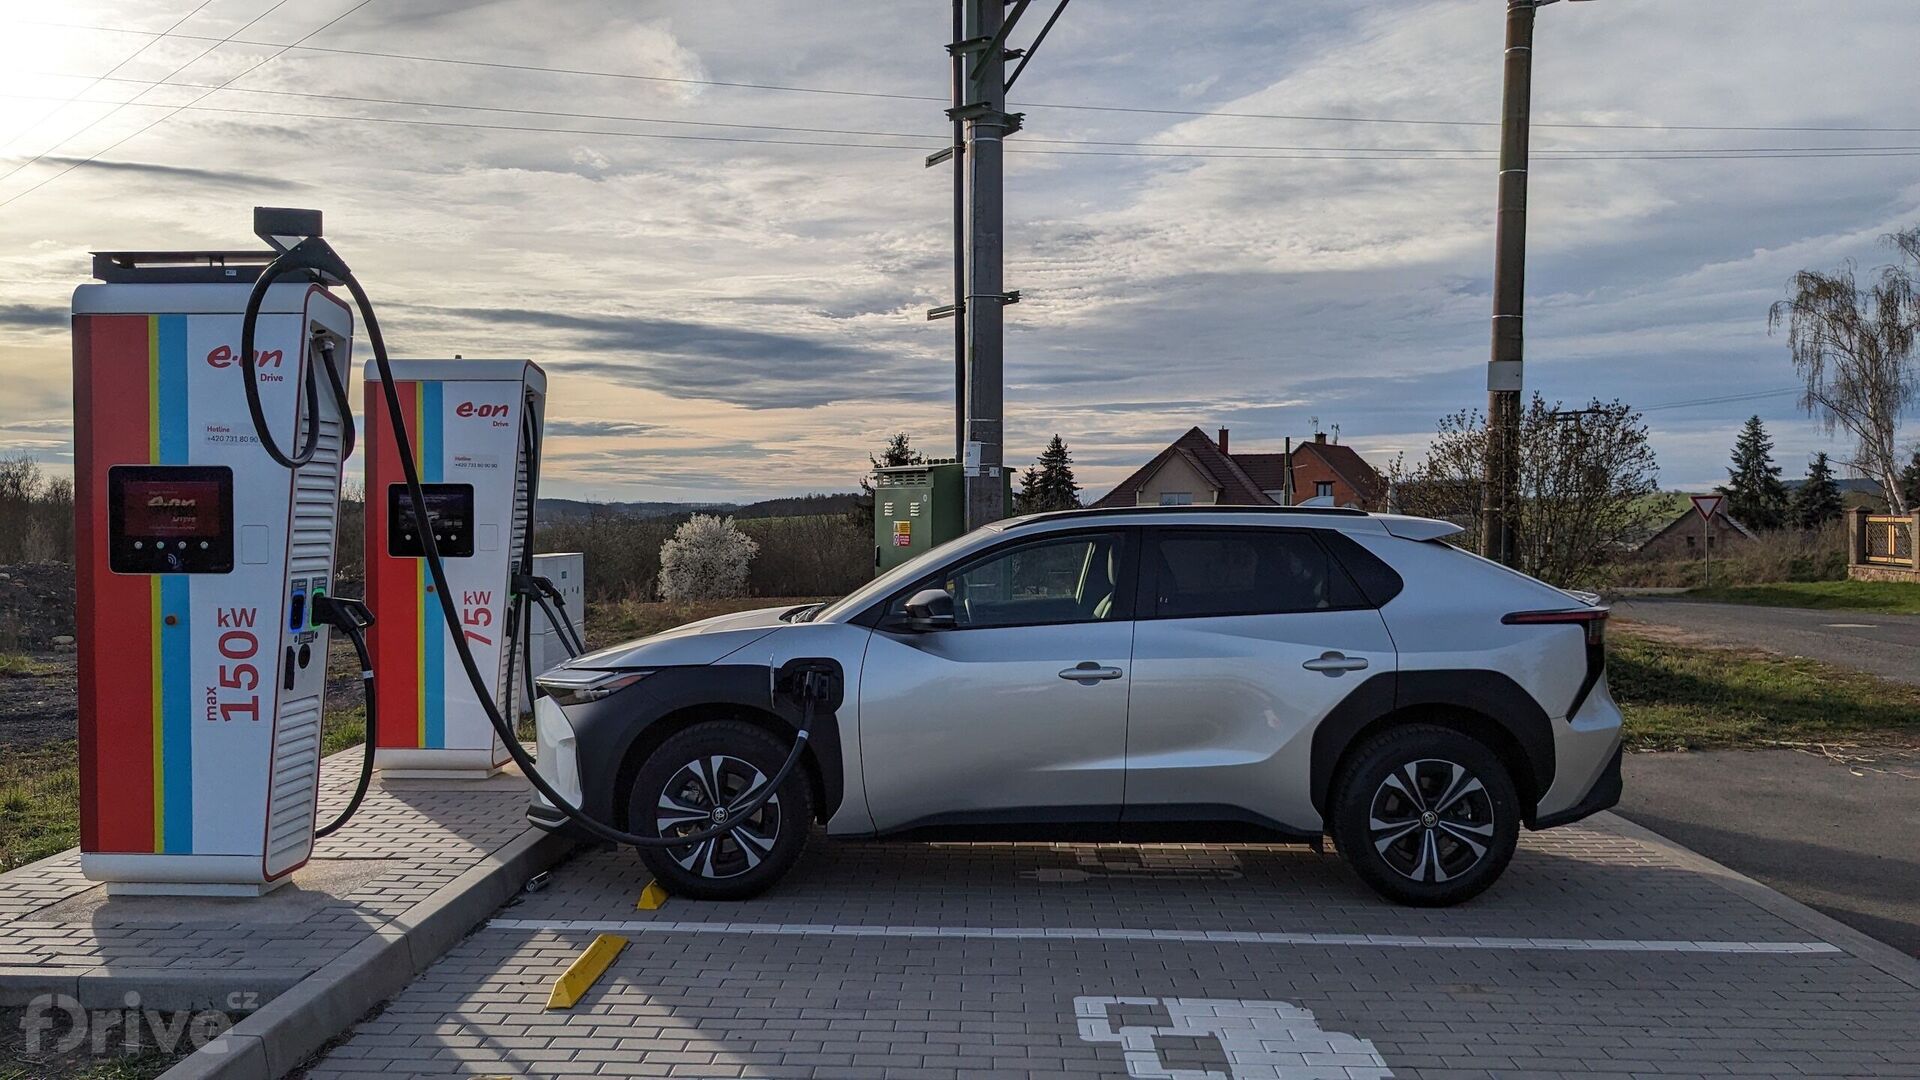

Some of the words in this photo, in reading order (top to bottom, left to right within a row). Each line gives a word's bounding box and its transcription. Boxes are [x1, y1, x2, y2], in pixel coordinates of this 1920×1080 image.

[260, 373, 284, 382] Drive
[463, 591, 492, 605] kW
[217, 607, 257, 628] kW
[463, 607, 492, 646] 75
[218, 630, 260, 722] 150
[206, 686, 218, 721] max
